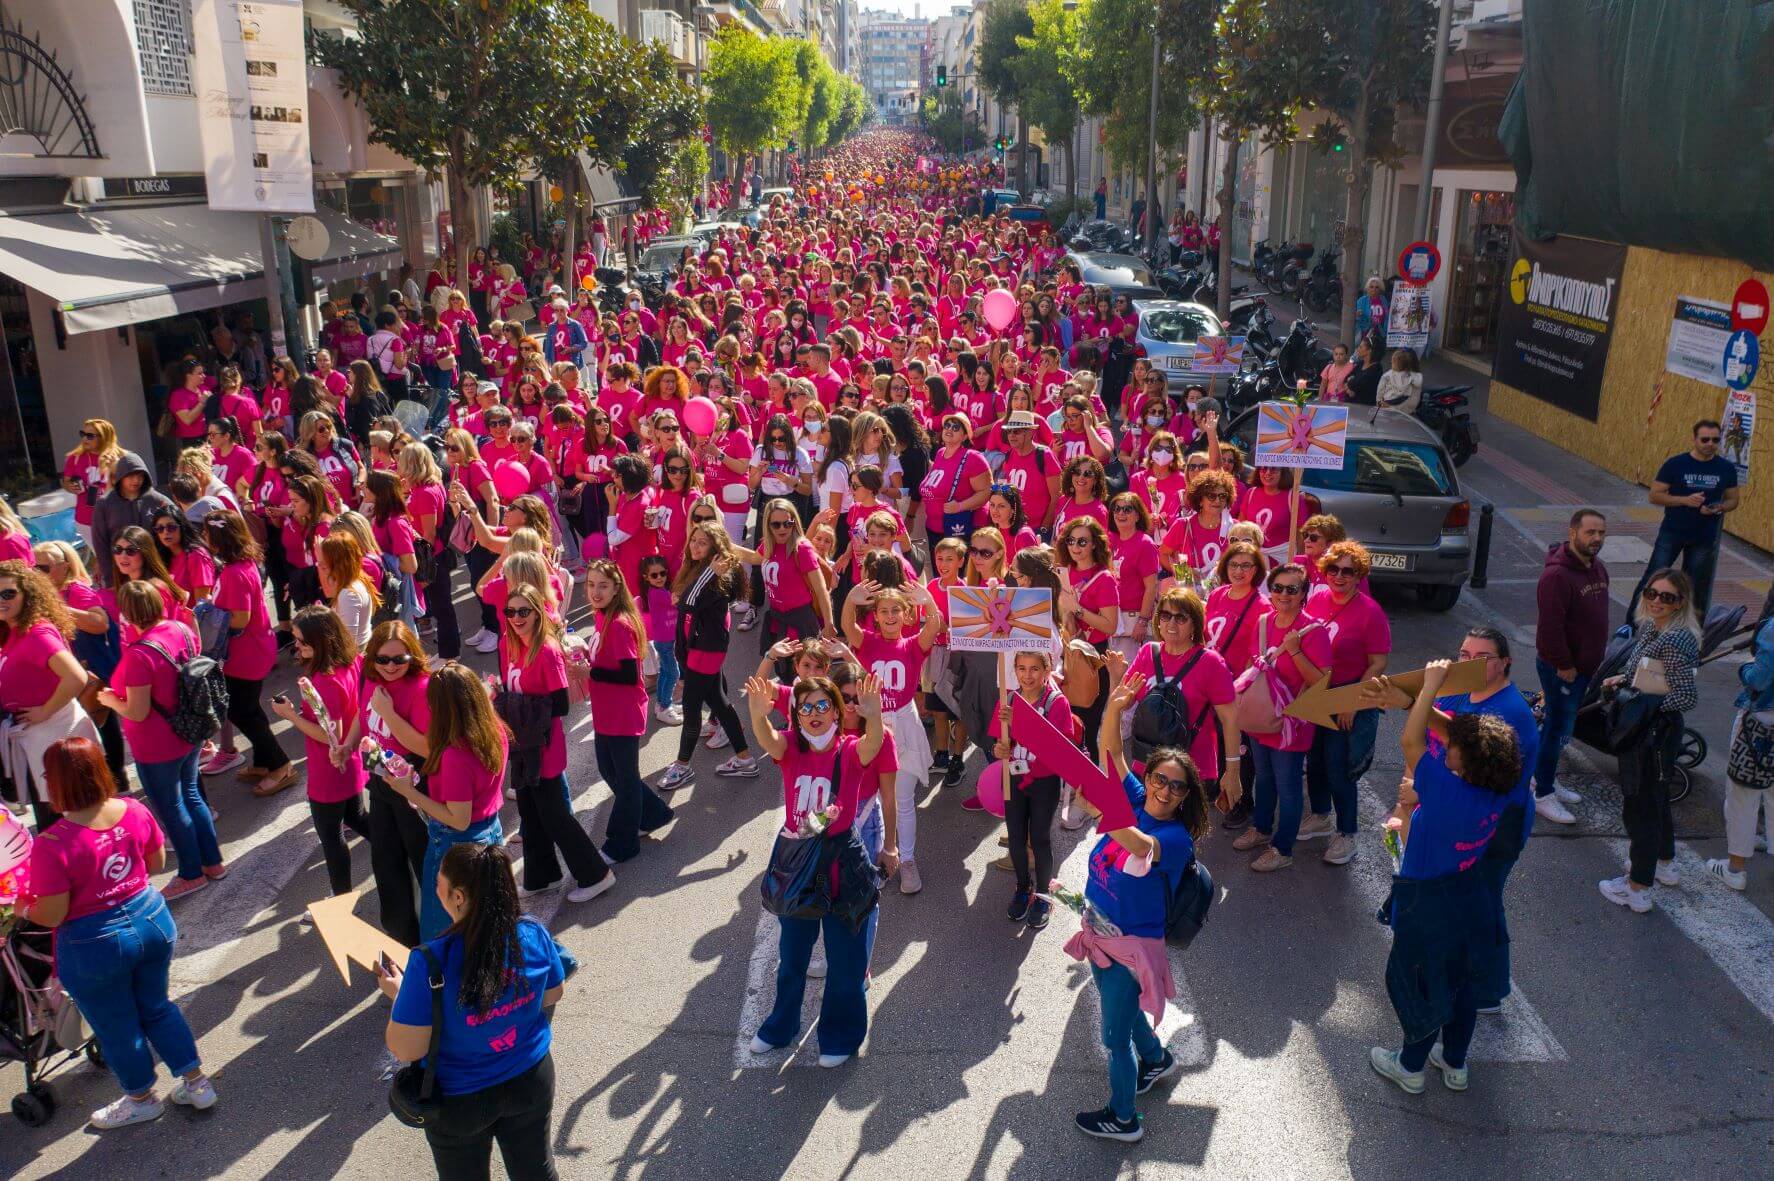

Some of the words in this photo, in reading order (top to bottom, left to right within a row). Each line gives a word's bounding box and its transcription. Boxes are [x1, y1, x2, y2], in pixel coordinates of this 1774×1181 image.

[135, 180, 170, 192] BODEGAS
[970, 402, 984, 418] 10
[1066, 441, 1085, 458] 10
[587, 455, 607, 472] 10
[920, 469, 944, 488] 10
[1008, 469, 1027, 490] 10
[872, 660, 905, 691] 10
[794, 775, 831, 814] 10
